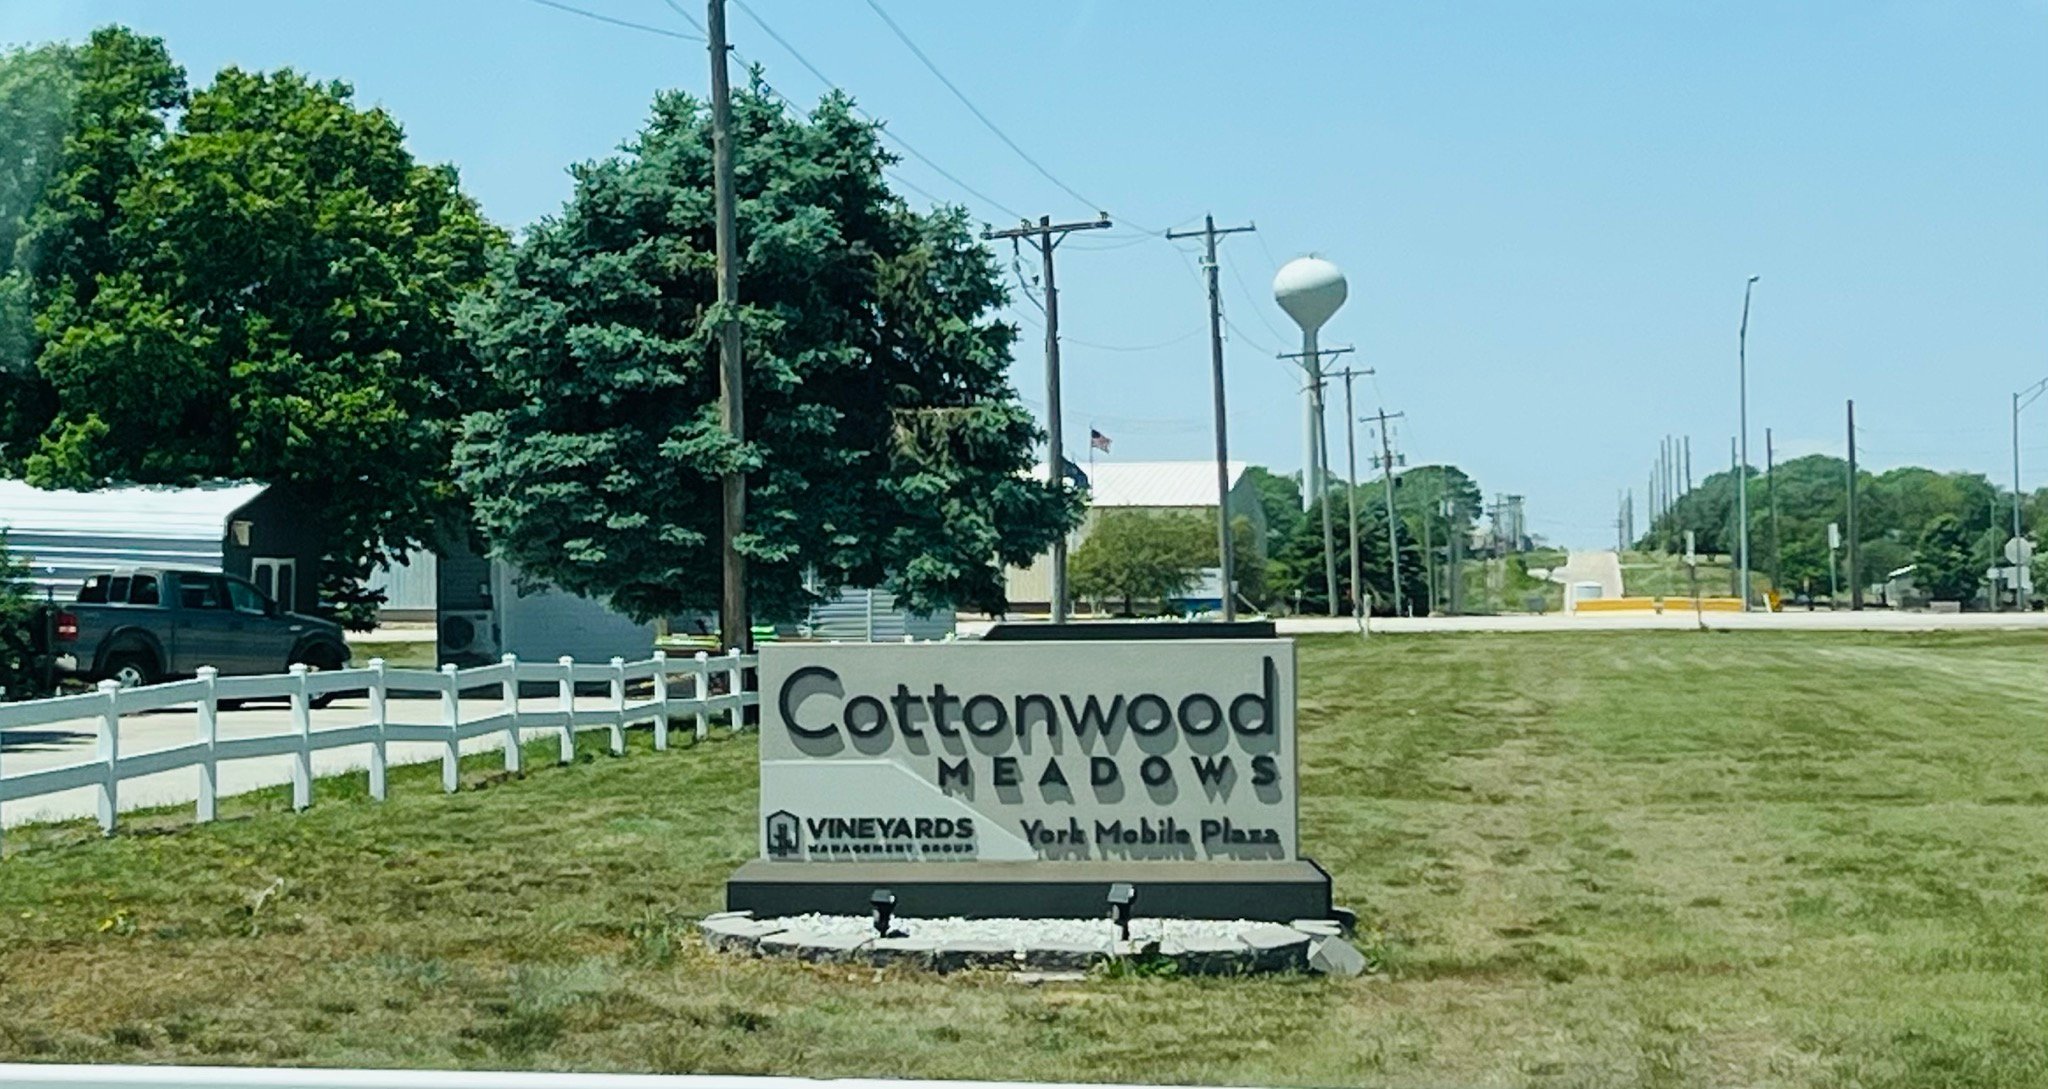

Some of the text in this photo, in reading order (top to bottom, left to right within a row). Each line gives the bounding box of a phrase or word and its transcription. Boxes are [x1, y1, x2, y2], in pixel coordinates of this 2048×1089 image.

[778, 655, 1275, 739] Cottonwood
[938, 755, 1277, 787] MEADOWS
[806, 817, 974, 839] VINEYARDS
[1020, 816, 1281, 845] York Mobile Plaza
[807, 843, 974, 853] MANAGEMENT GROUP
